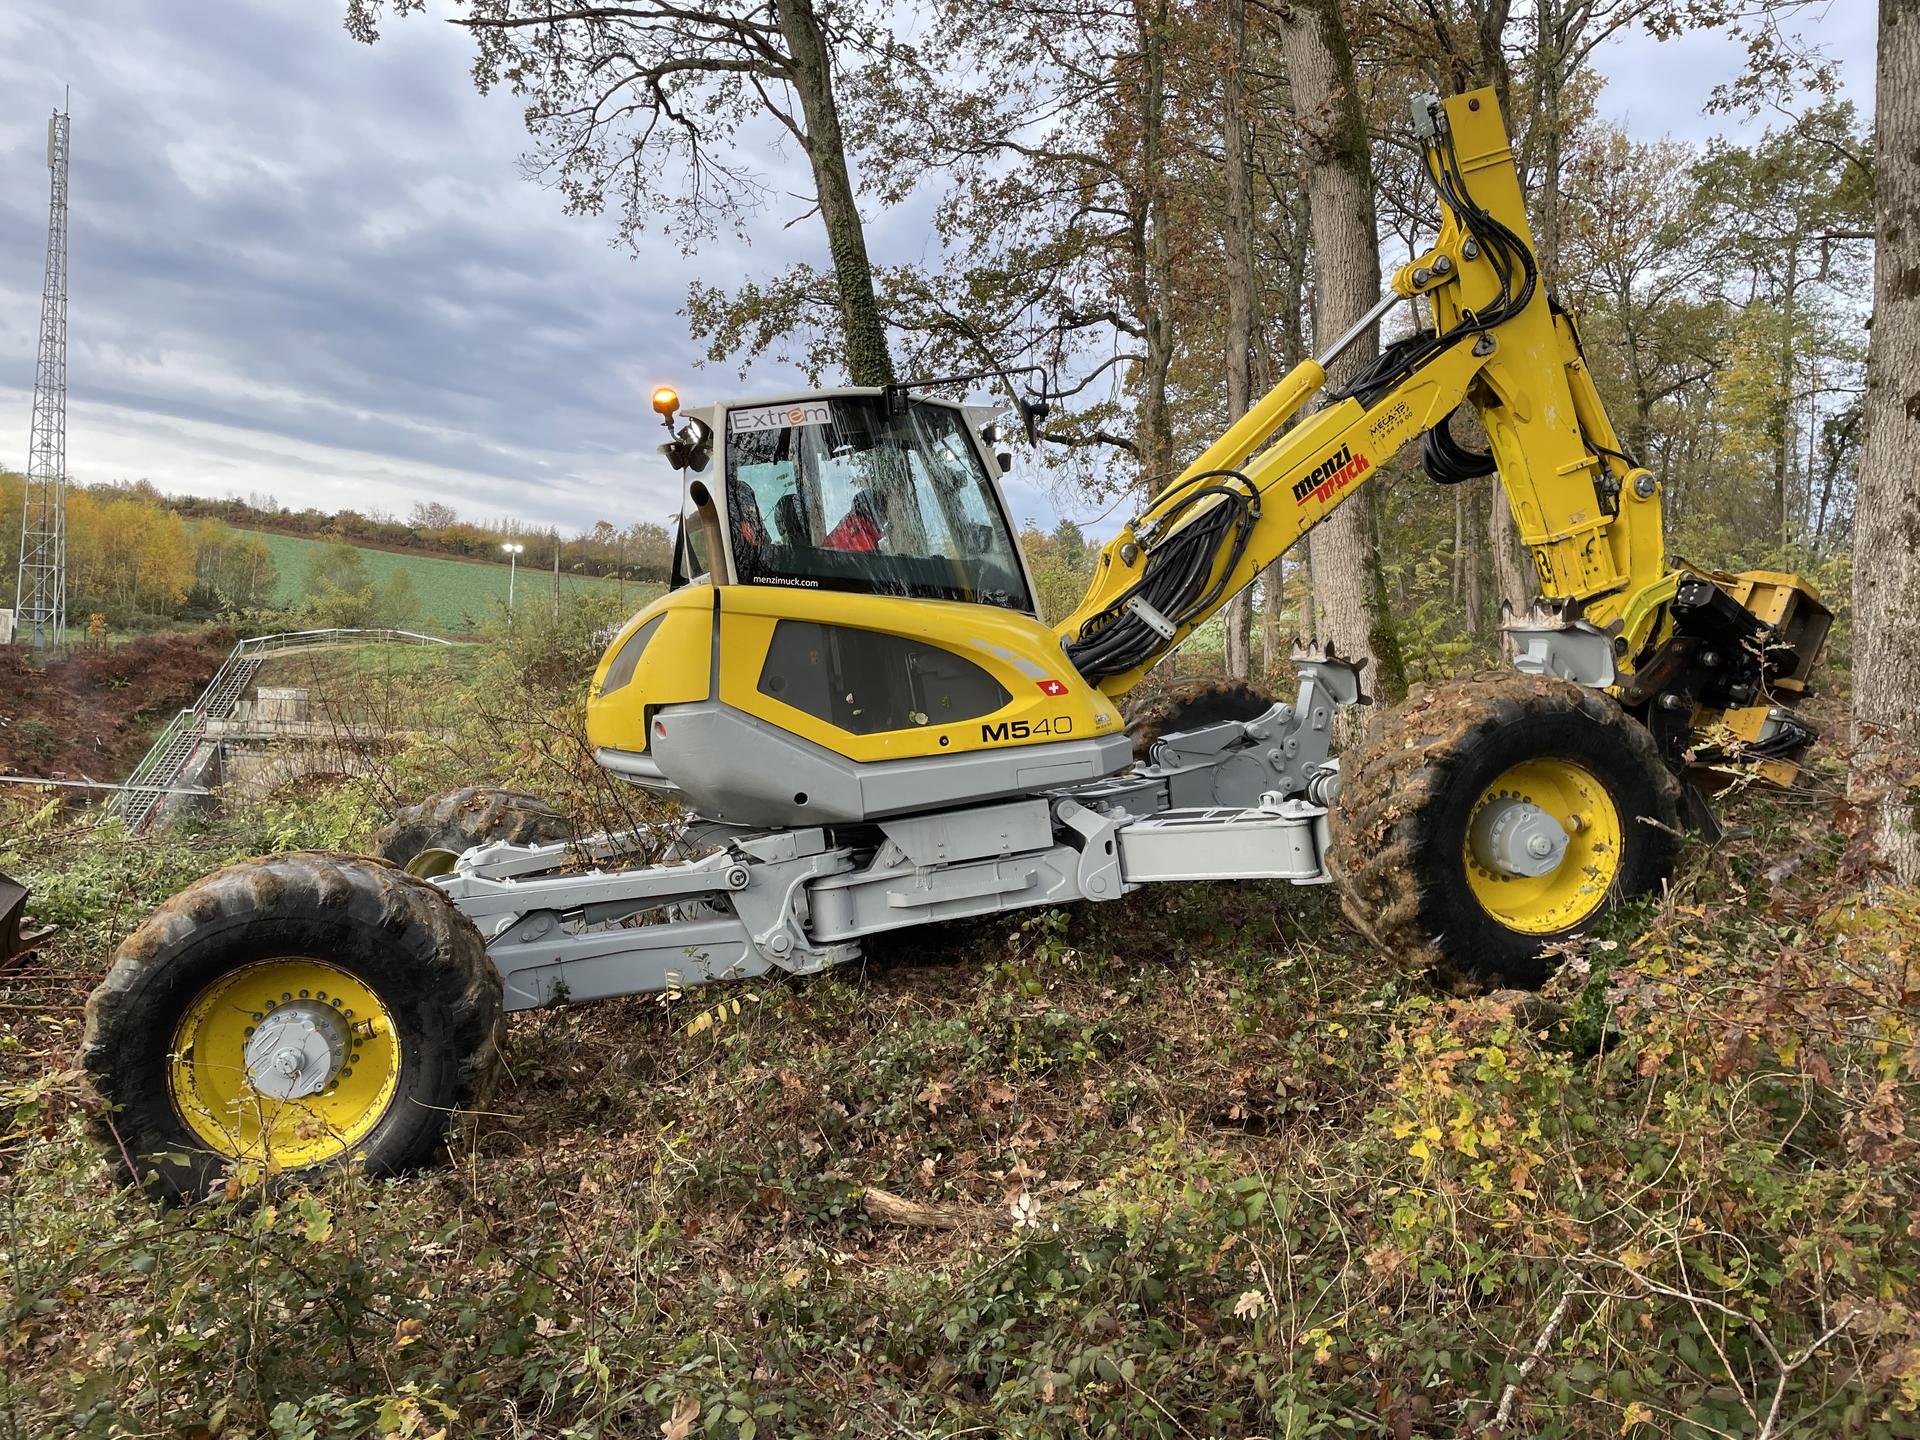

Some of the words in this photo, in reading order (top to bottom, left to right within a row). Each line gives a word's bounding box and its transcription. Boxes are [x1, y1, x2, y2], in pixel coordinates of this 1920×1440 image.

[732, 407, 829, 430] Extrem
[1291, 442, 1352, 501] menzi
[1297, 453, 1371, 506] muck
[753, 576, 819, 587] menzimuck.com
[981, 716, 1073, 743] M540
